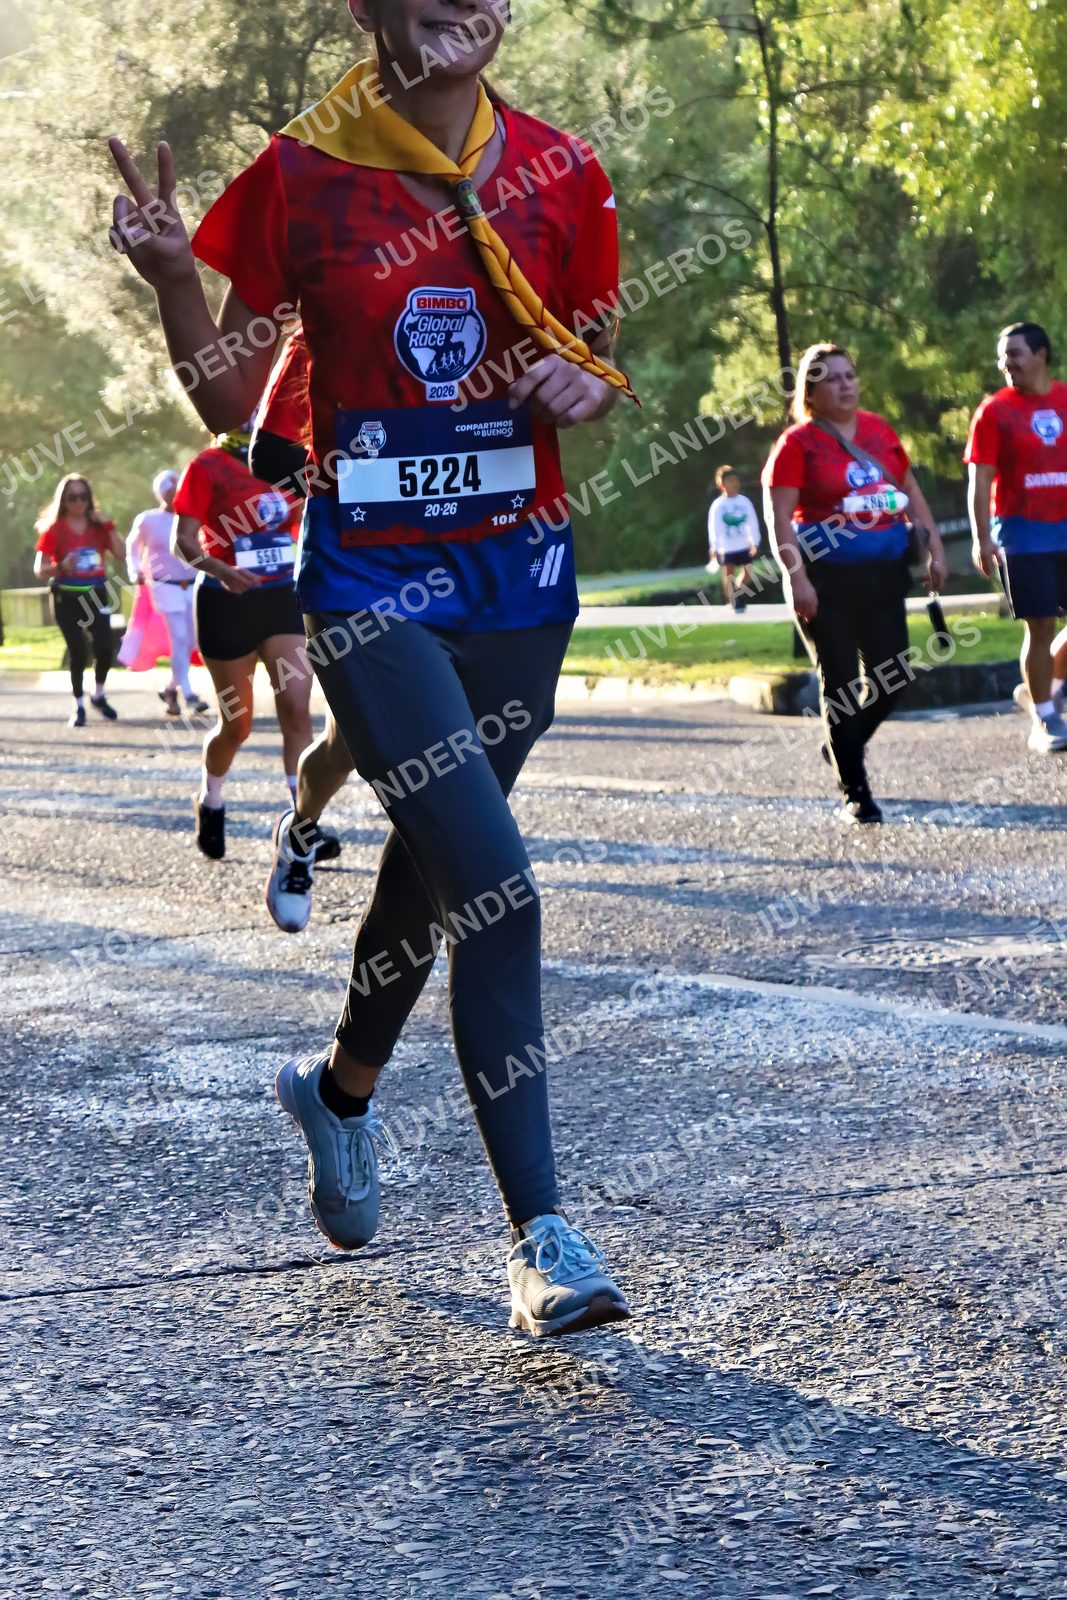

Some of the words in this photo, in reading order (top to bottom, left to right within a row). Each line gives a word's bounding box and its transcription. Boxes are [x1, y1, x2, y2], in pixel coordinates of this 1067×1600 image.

[416, 298, 468, 309] BIMBO
[418, 315, 465, 332] Global
[408, 331, 447, 348] Race
[429, 386, 456, 399] 2026
[455, 420, 513, 432] COMPARTIMOS
[398, 455, 481, 497] 5224
[491, 513, 518, 526] 10K
